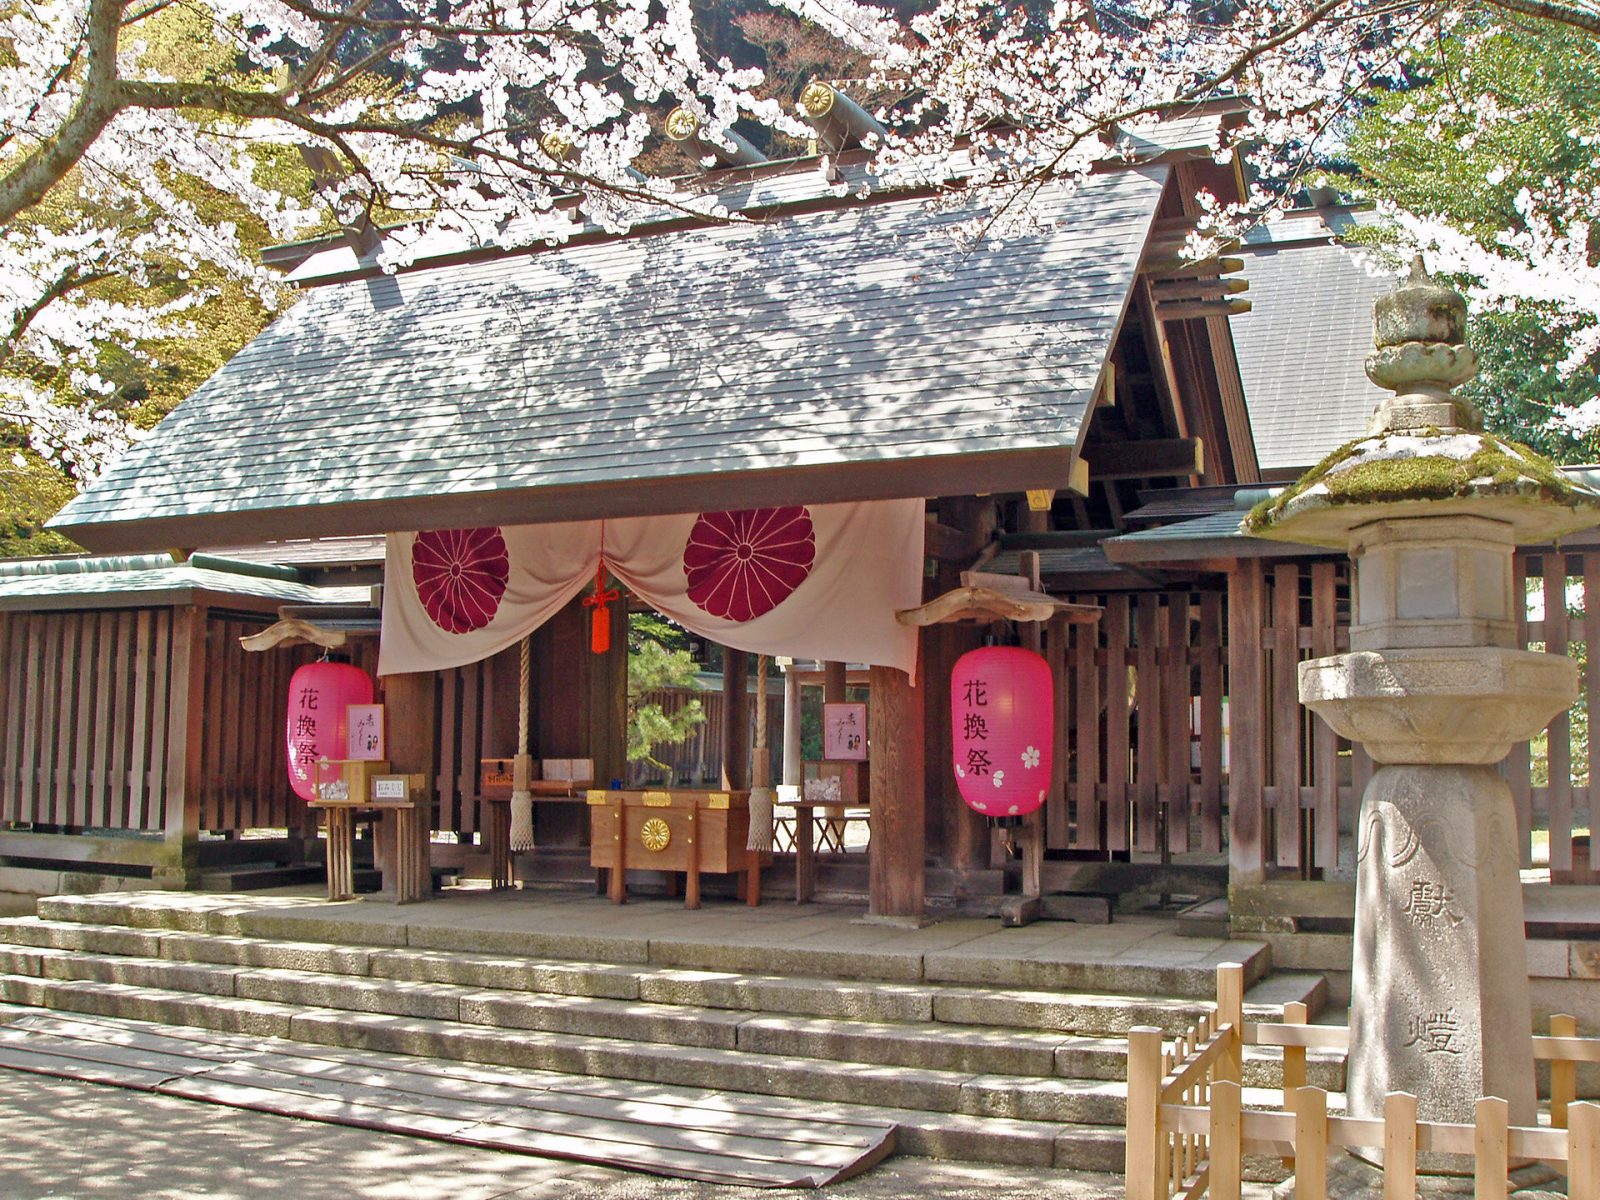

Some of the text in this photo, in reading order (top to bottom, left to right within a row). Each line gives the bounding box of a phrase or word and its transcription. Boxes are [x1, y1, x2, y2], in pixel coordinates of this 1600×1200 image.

[296, 688, 319, 764] 花換祭
[963, 680, 991, 776] 花換祭
